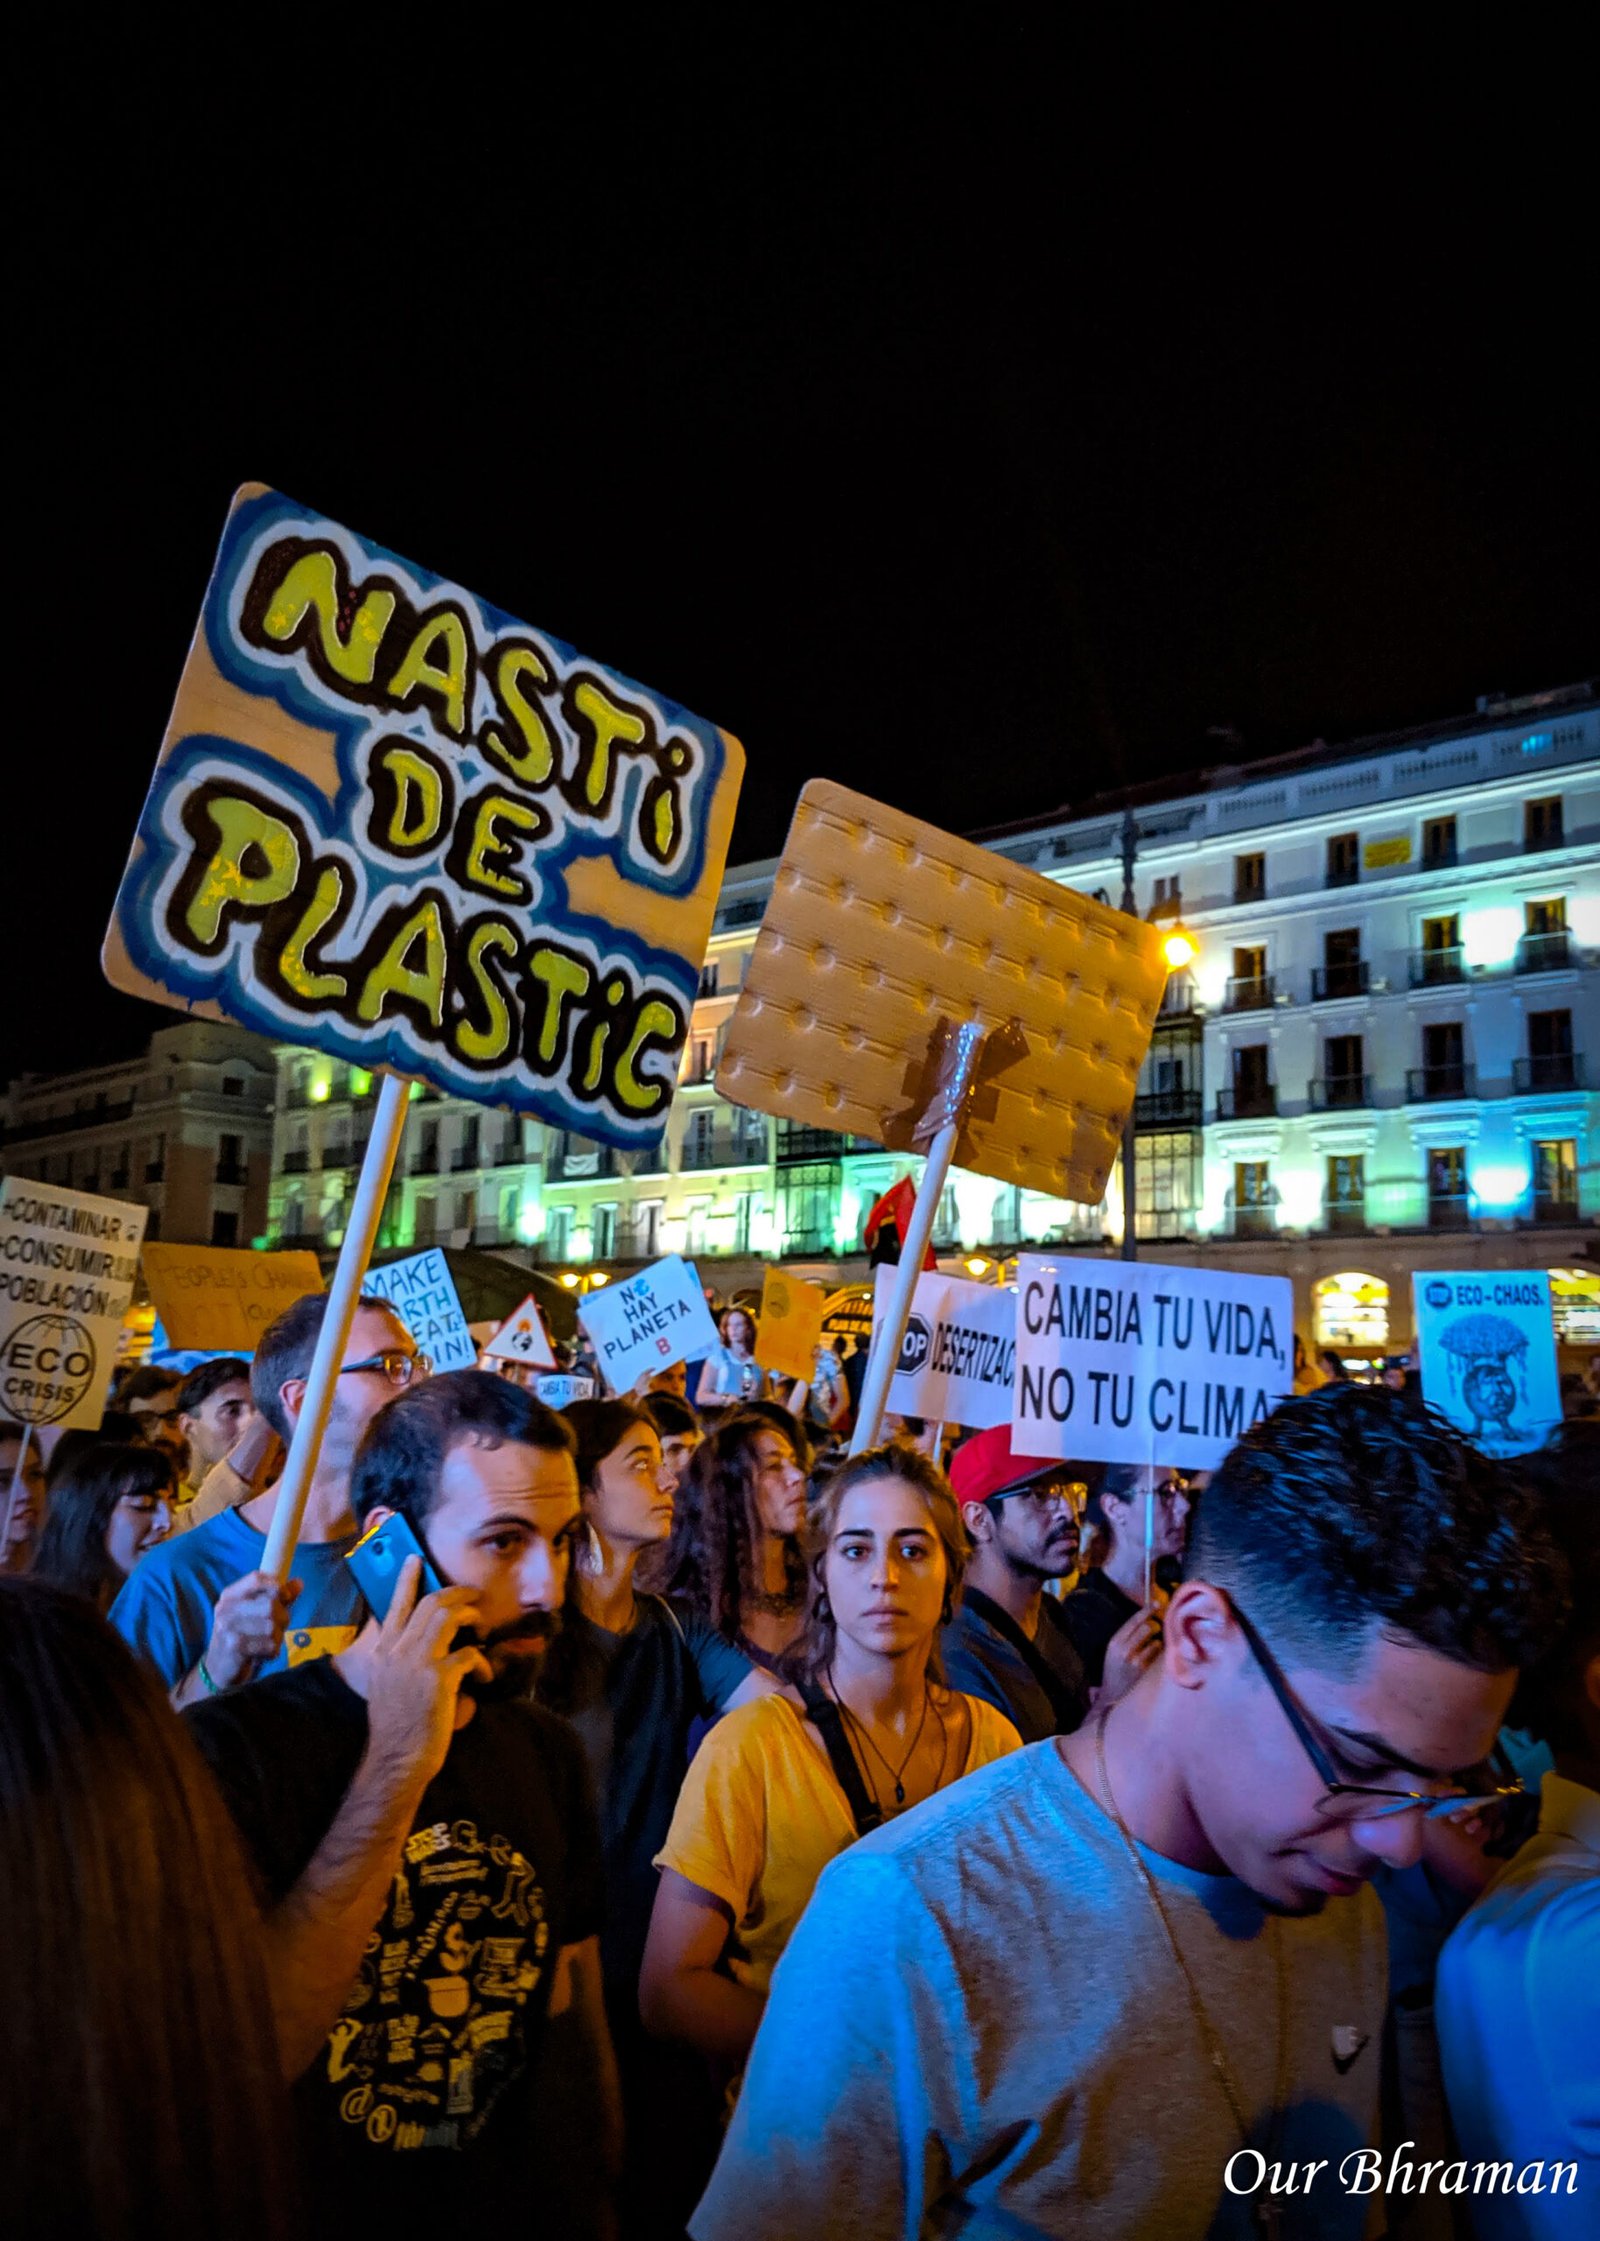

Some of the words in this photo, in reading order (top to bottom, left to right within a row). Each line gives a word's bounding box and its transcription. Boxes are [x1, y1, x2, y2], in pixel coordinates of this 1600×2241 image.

[368, 734, 552, 906] DE
[363, 1252, 441, 1300] MAKE
[403, 1286, 452, 1321] RTH
[623, 1291, 658, 1324] HAY
[1024, 1281, 1143, 1345] CAMBIA
[1153, 1294, 1195, 1350] TU
[1203, 1299, 1286, 1371] VIDA,
[603, 1298, 692, 1360] PLANETA
[655, 1337, 671, 1356] B
[8, 1343, 90, 1377] ECO
[902, 1331, 926, 1359] OP
[931, 1321, 1016, 1389] DESERTIZAC
[4, 1377, 76, 1403] CRISIS
[1020, 1365, 1075, 1422] NO
[1087, 1371, 1135, 1428] TU
